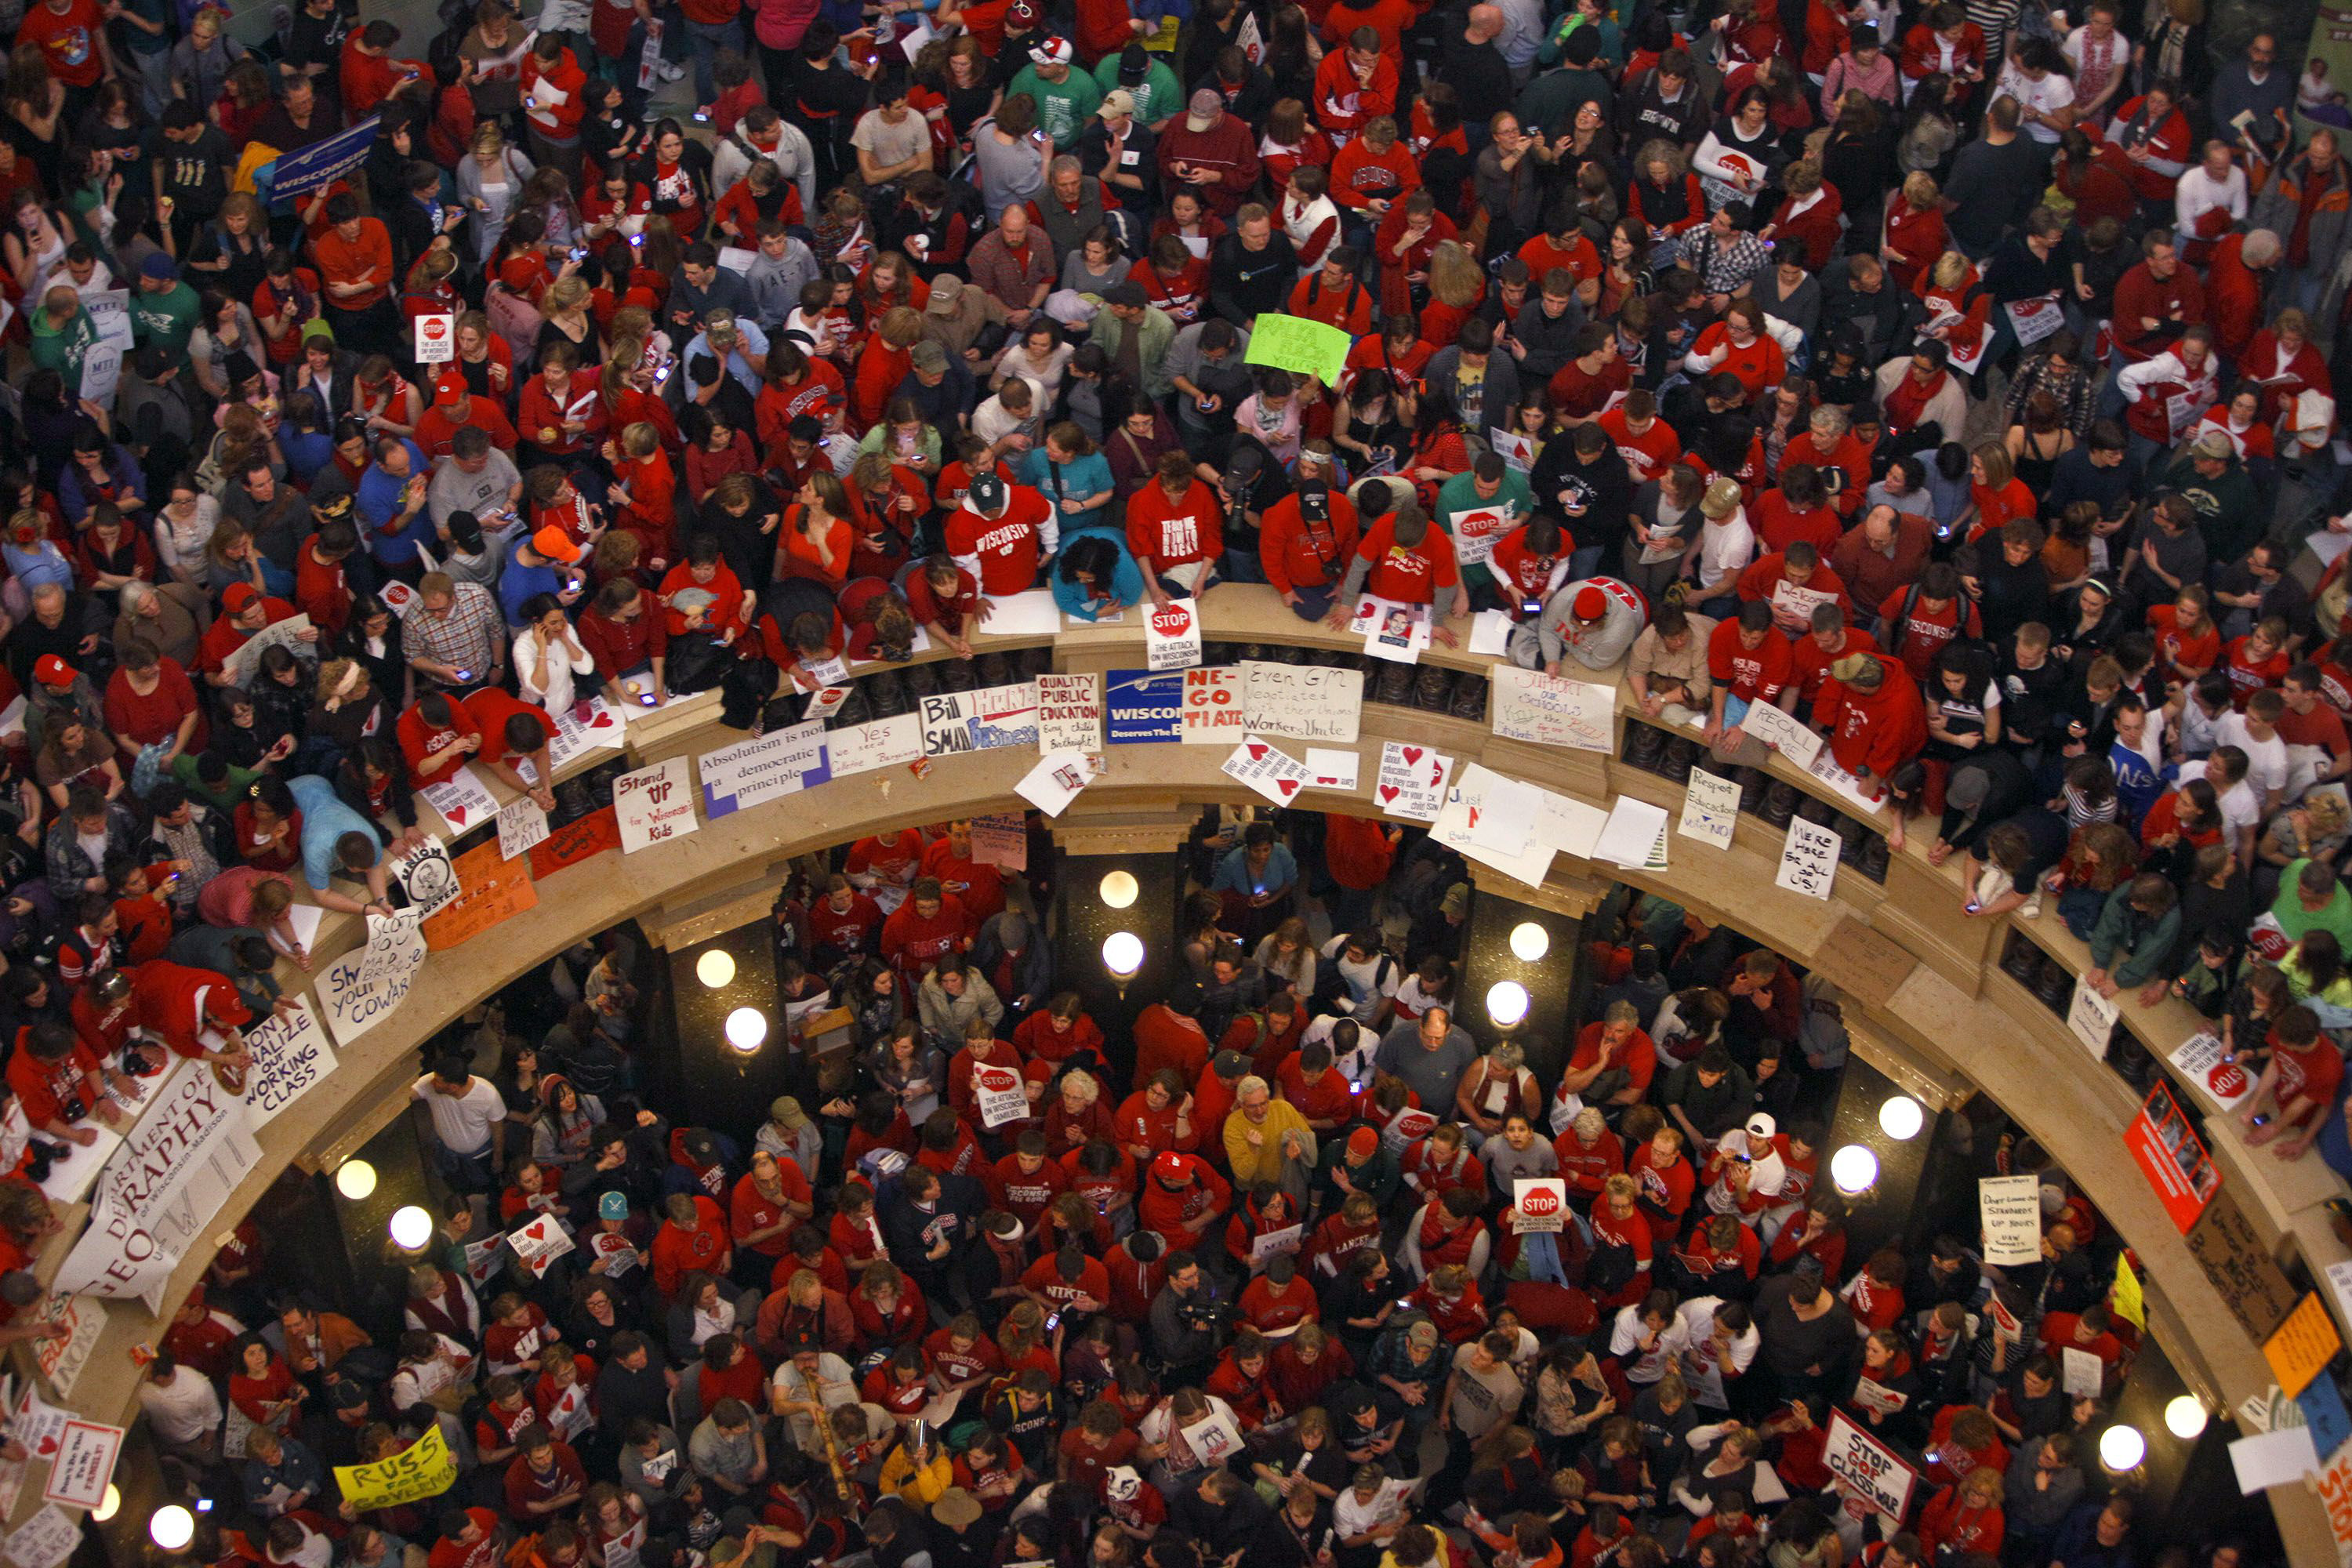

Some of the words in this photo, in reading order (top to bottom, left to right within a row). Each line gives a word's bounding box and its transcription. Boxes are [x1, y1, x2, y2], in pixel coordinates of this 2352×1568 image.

[423, 324, 445, 333] STOP
[1461, 518, 1497, 534] STOP
[388, 587, 408, 601] STOP
[1154, 613, 1188, 628] STOP
[1155, 643, 1169, 652] THE
[1170, 641, 1194, 650] ATTACK
[1151, 653, 1161, 662] ON
[1162, 649, 1200, 661] WISCONSIN
[1161, 658, 1191, 670] FAMILIES
[1040, 676, 1094, 688] QUALITY
[1188, 670, 1236, 686] NE-
[1250, 664, 1295, 687] Even
[1305, 668, 1347, 688] GM
[1041, 689, 1091, 703] PUBLIC
[1189, 689, 1232, 707] GO
[924, 695, 961, 724] Bill
[1040, 706, 1099, 721] EDUCATION
[859, 724, 891, 743] Yes
[1112, 728, 1152, 739] Deserves
[1154, 728, 1171, 737] The
[1243, 713, 1305, 737] Workers
[1305, 719, 1347, 737] Unite
[1756, 708, 1811, 753] RECALL
[702, 739, 782, 771] Absolutism
[786, 731, 798, 744] is
[801, 724, 825, 739] not
[1385, 742, 1400, 753] Care
[1759, 725, 1799, 761] TIME
[714, 778, 722, 788] a
[737, 746, 815, 779] democratic
[1384, 753, 1402, 764] about
[1382, 764, 1412, 778] educators
[619, 765, 666, 796] Stand
[738, 768, 801, 799] principle
[1381, 775, 1392, 785] like
[1393, 777, 1406, 788] they
[1406, 780, 1421, 789] care
[646, 782, 673, 804] UP
[1401, 789, 1410, 798] for
[1410, 791, 1425, 800] your
[1449, 789, 1481, 805] Just
[629, 817, 642, 826] for
[647, 800, 695, 824] Wisconsin's
[648, 823, 673, 841] Kids
[401, 847, 441, 881] UNION
[417, 884, 459, 919] BUSTER
[245, 1043, 319, 1106] WORKING
[983, 1076, 1014, 1086] STOP
[2213, 1066, 2246, 1095] STOP
[181, 1068, 205, 1101] OF
[263, 1062, 318, 1112] CLASS
[993, 1099, 1027, 1113] WISCONSIN
[998, 1093, 1021, 1102] ATTACK
[1399, 1119, 1431, 1132] STOP
[1524, 1199, 1557, 1212] STOP
[510, 1233, 525, 1246] Care
[518, 1240, 534, 1254] about
[1047, 1286, 1087, 1302] NIKE
[352, 1435, 438, 1488] RUSS
[1848, 1432, 1893, 1476] STOP
[1846, 1450, 1881, 1483] GOP
[353, 1461, 459, 1512] GOVERNOR
[386, 1470, 428, 1490] FOR
[1829, 1452, 1874, 1496] CLASS
[1874, 1485, 1900, 1517] WAR
